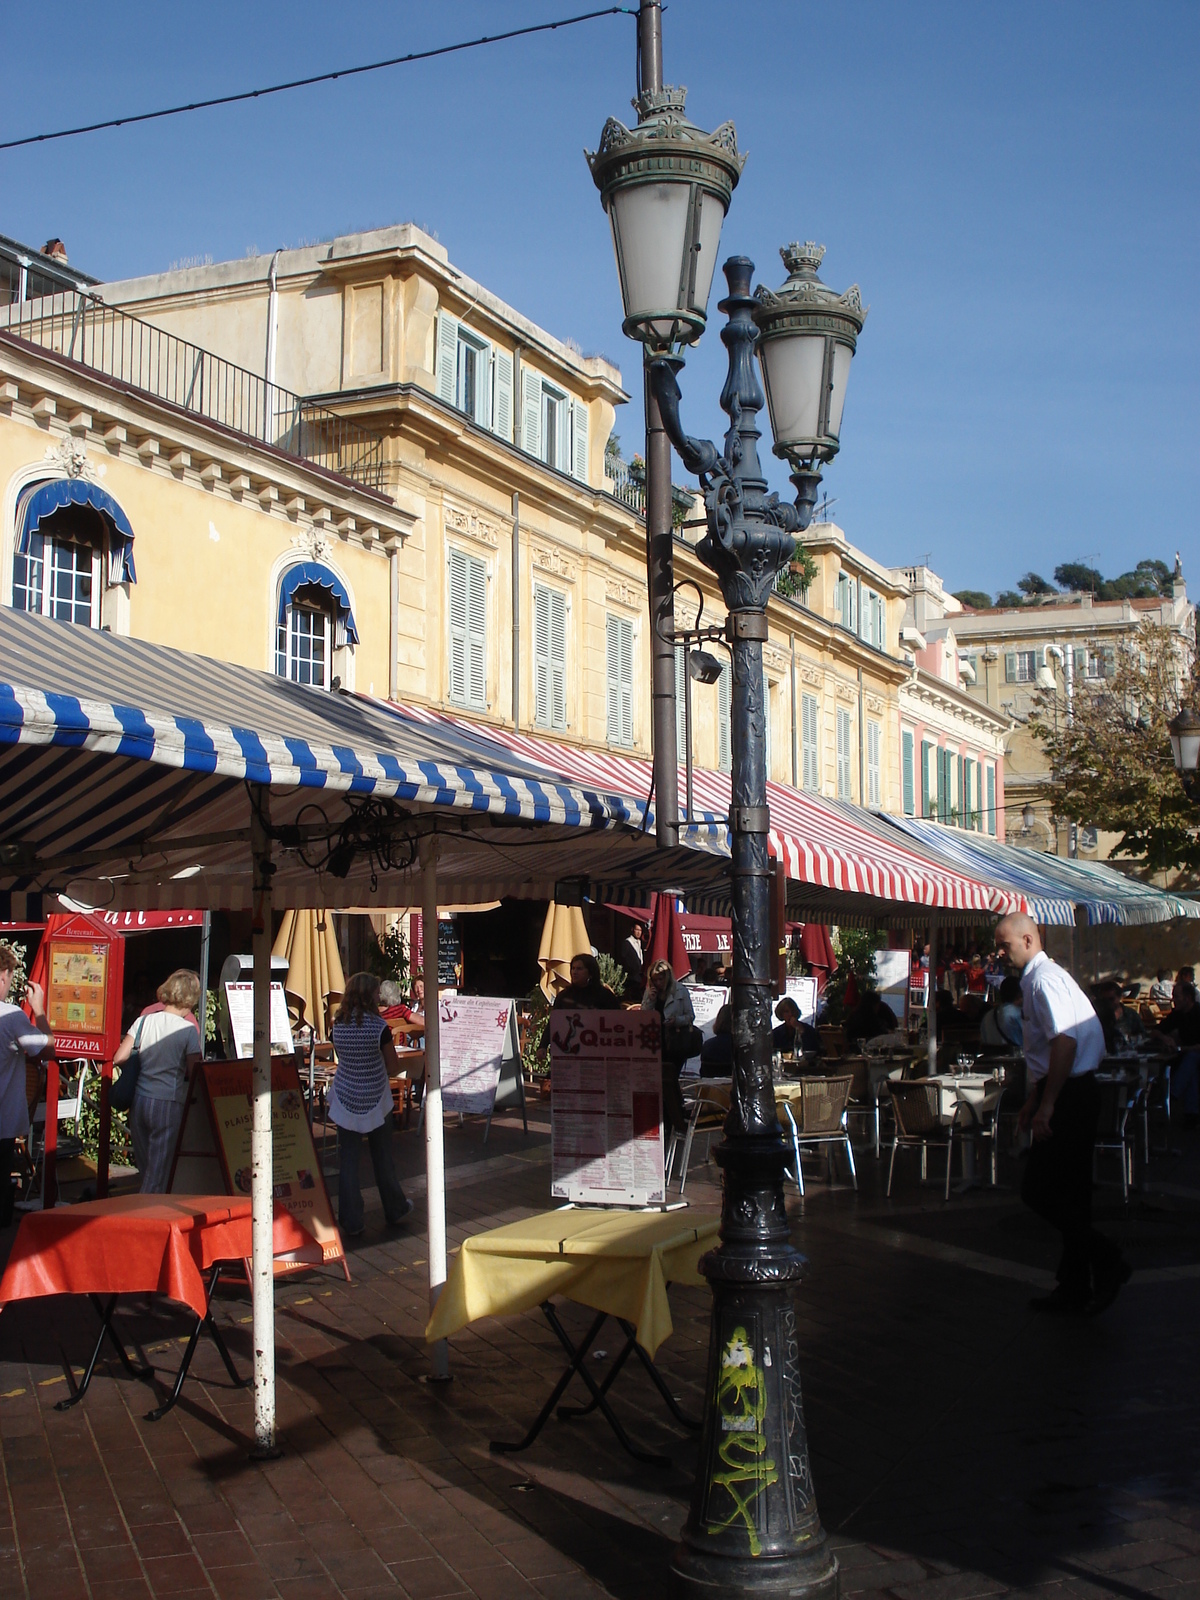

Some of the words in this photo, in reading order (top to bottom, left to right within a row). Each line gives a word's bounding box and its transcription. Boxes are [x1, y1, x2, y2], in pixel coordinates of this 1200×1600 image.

[600, 1016, 625, 1033] Le
[580, 1029, 633, 1047] Quai
[225, 1114, 253, 1128] PLAISI
[282, 1111, 300, 1120] DUO
